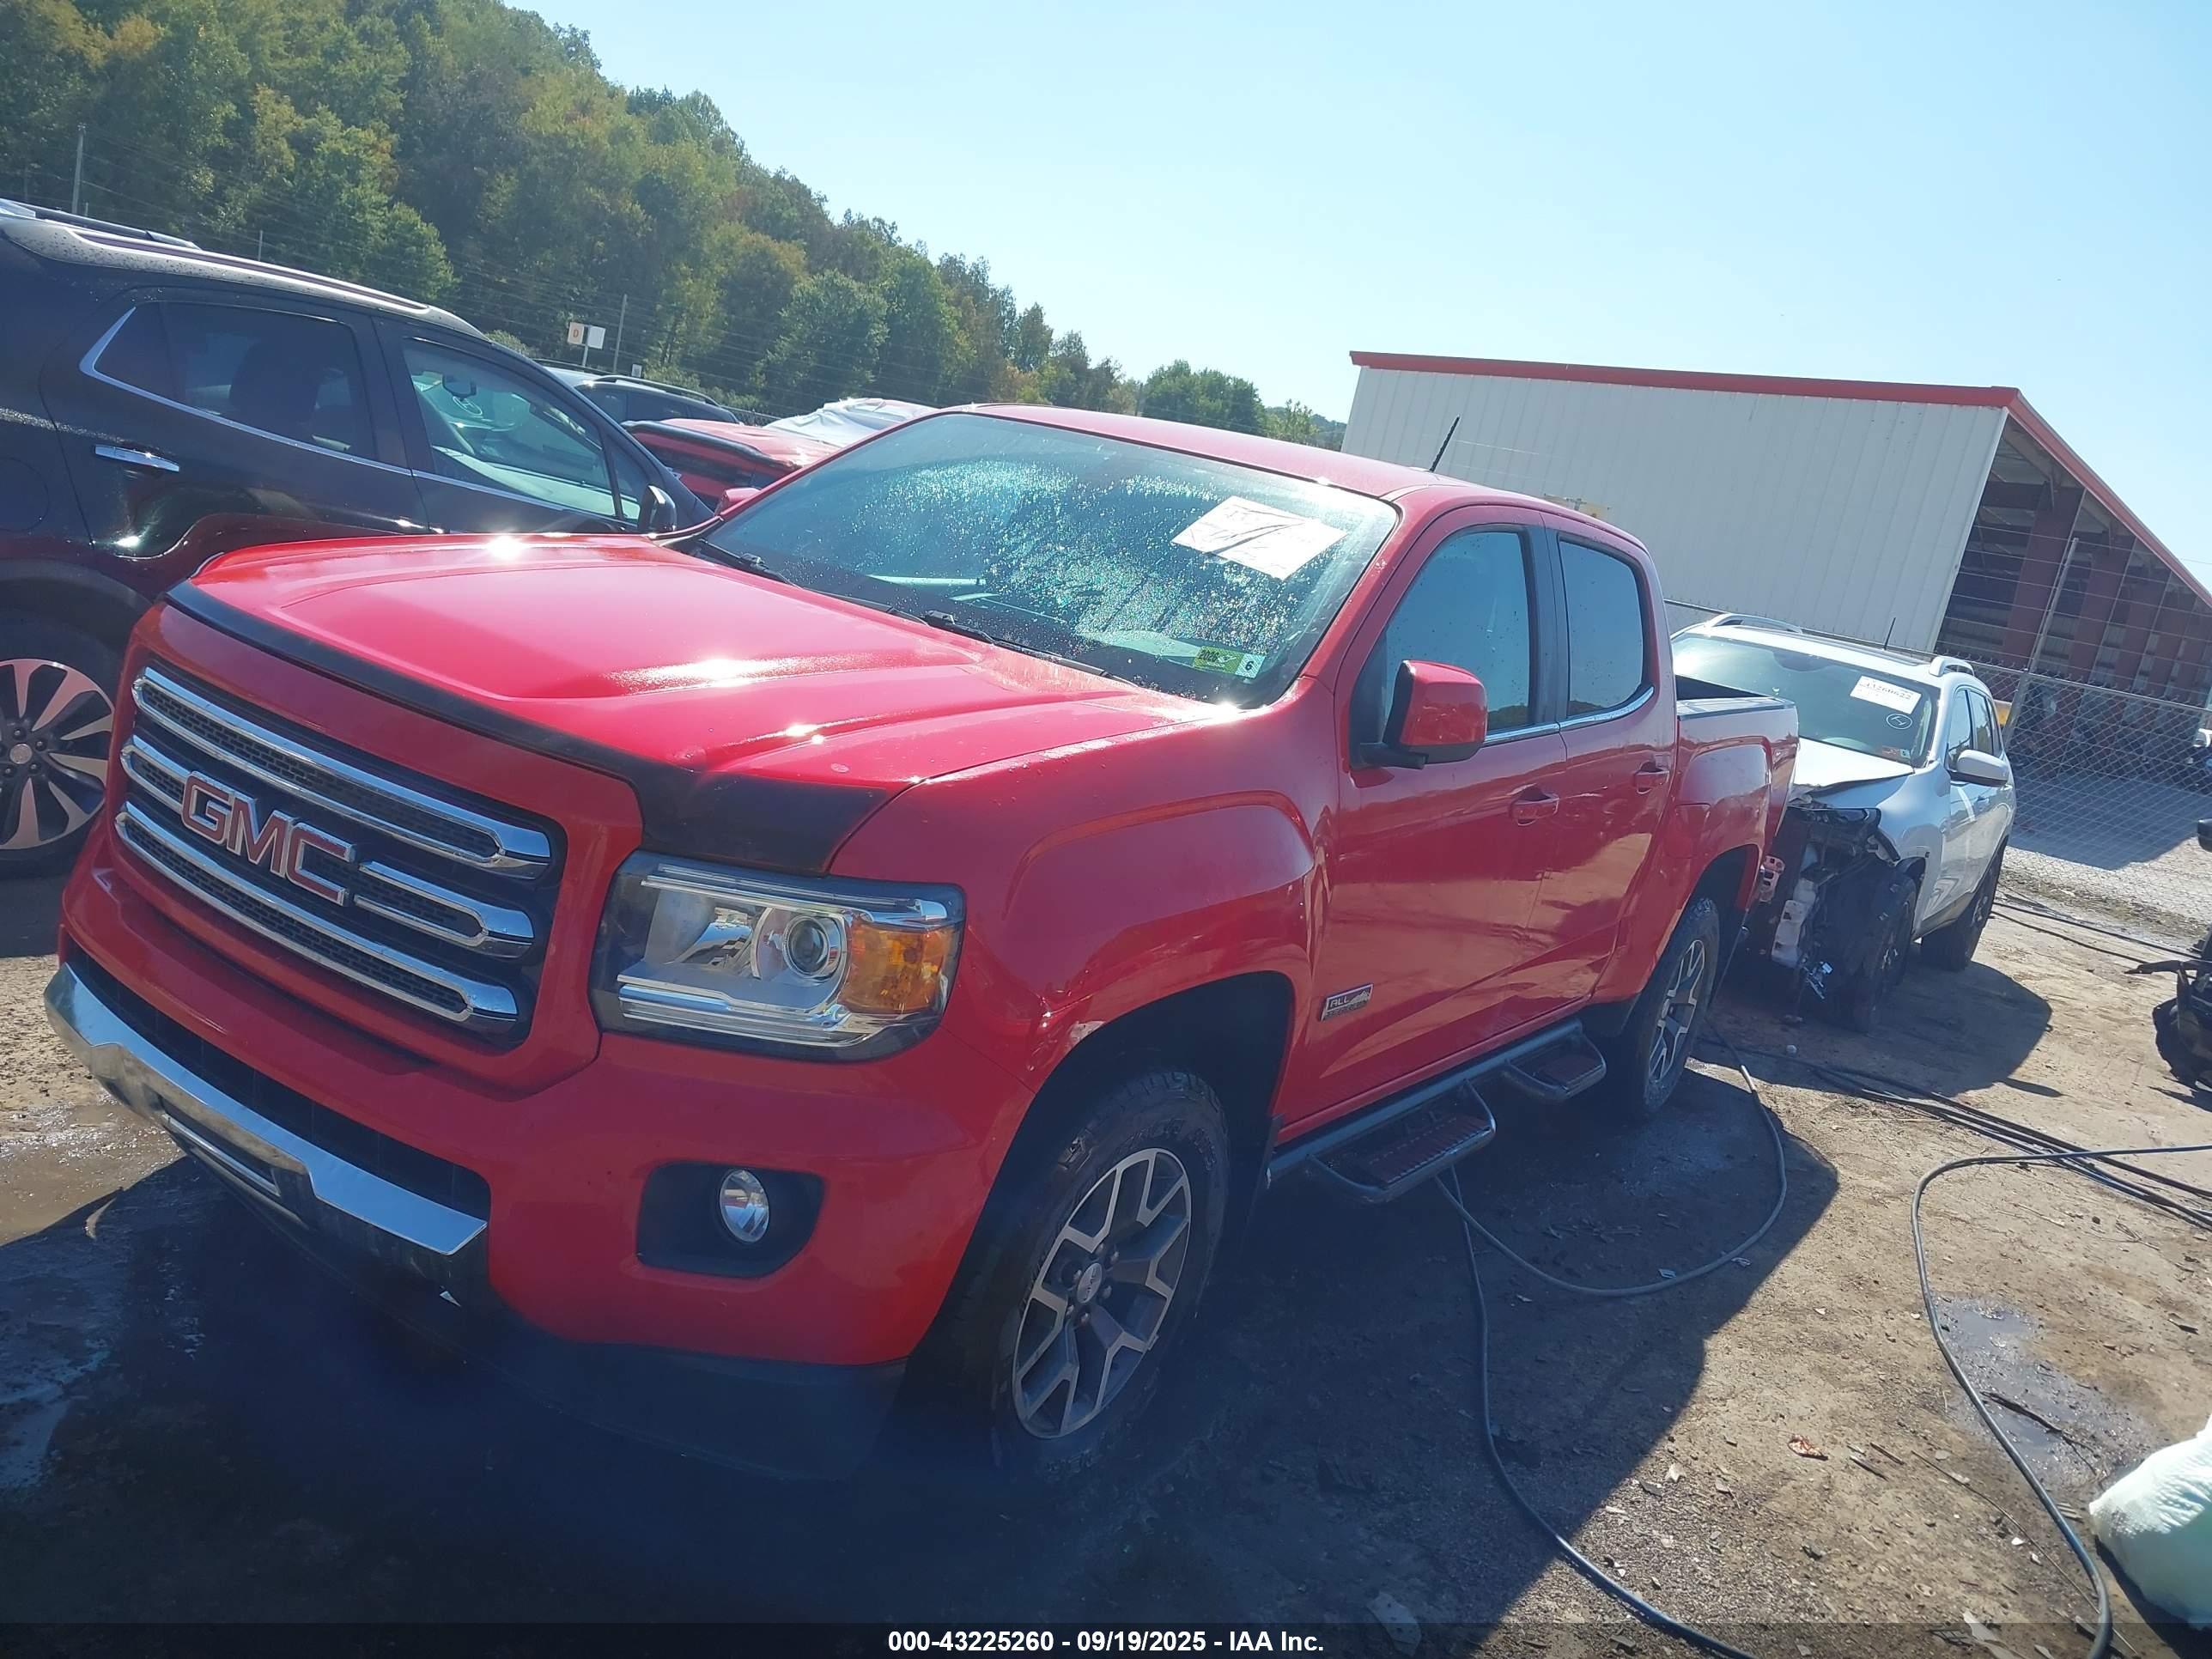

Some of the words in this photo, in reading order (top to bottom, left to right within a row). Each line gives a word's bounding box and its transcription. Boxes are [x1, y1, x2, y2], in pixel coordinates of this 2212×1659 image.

[1245, 660, 1255, 671] 6
[181, 771, 356, 906] GMC
[1330, 996, 1350, 1008] ALL
